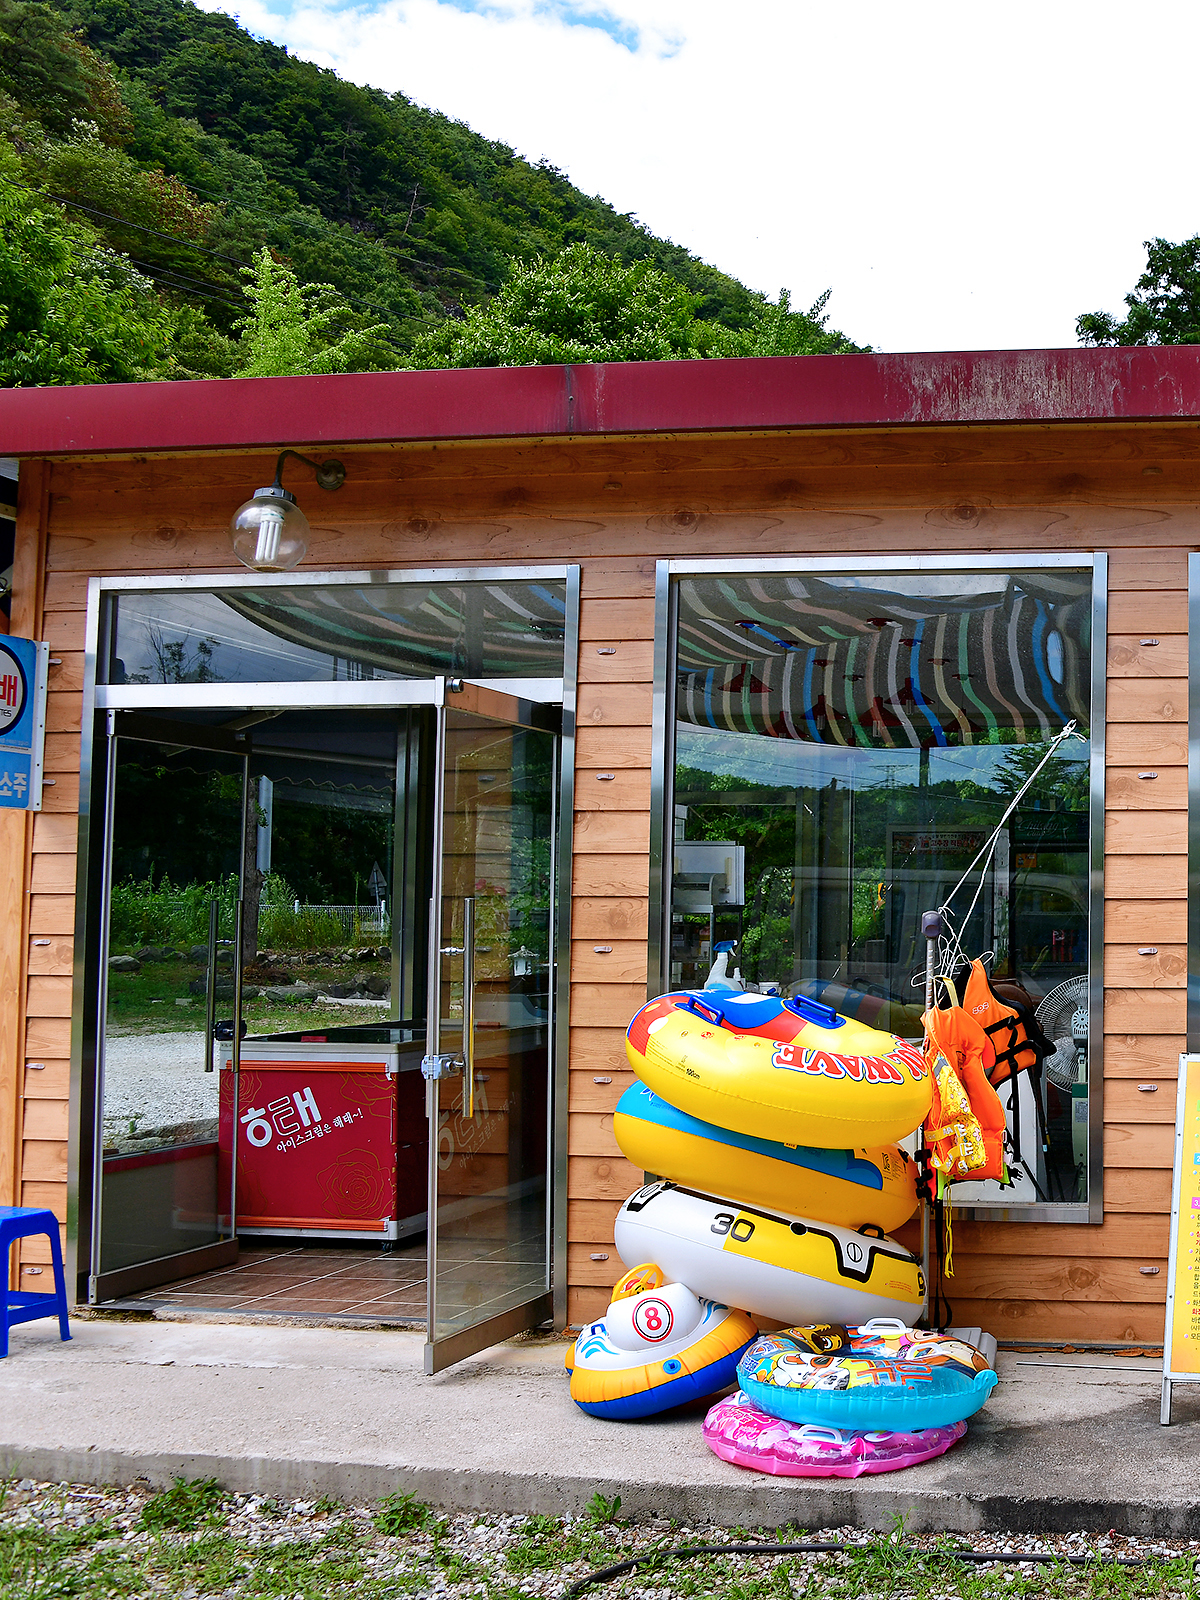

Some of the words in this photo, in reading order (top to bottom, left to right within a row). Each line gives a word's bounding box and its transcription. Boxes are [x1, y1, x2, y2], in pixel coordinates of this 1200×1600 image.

[0, 771, 27, 799] 소주
[773, 1041, 903, 1084] WAVE
[277, 1123, 332, 1153] 아이스크림은
[333, 1108, 364, 1129] 해태~!
[1193, 1199, 1200, 1207] 3.
[711, 1213, 755, 1243] 30
[645, 1307, 662, 1329] 8
